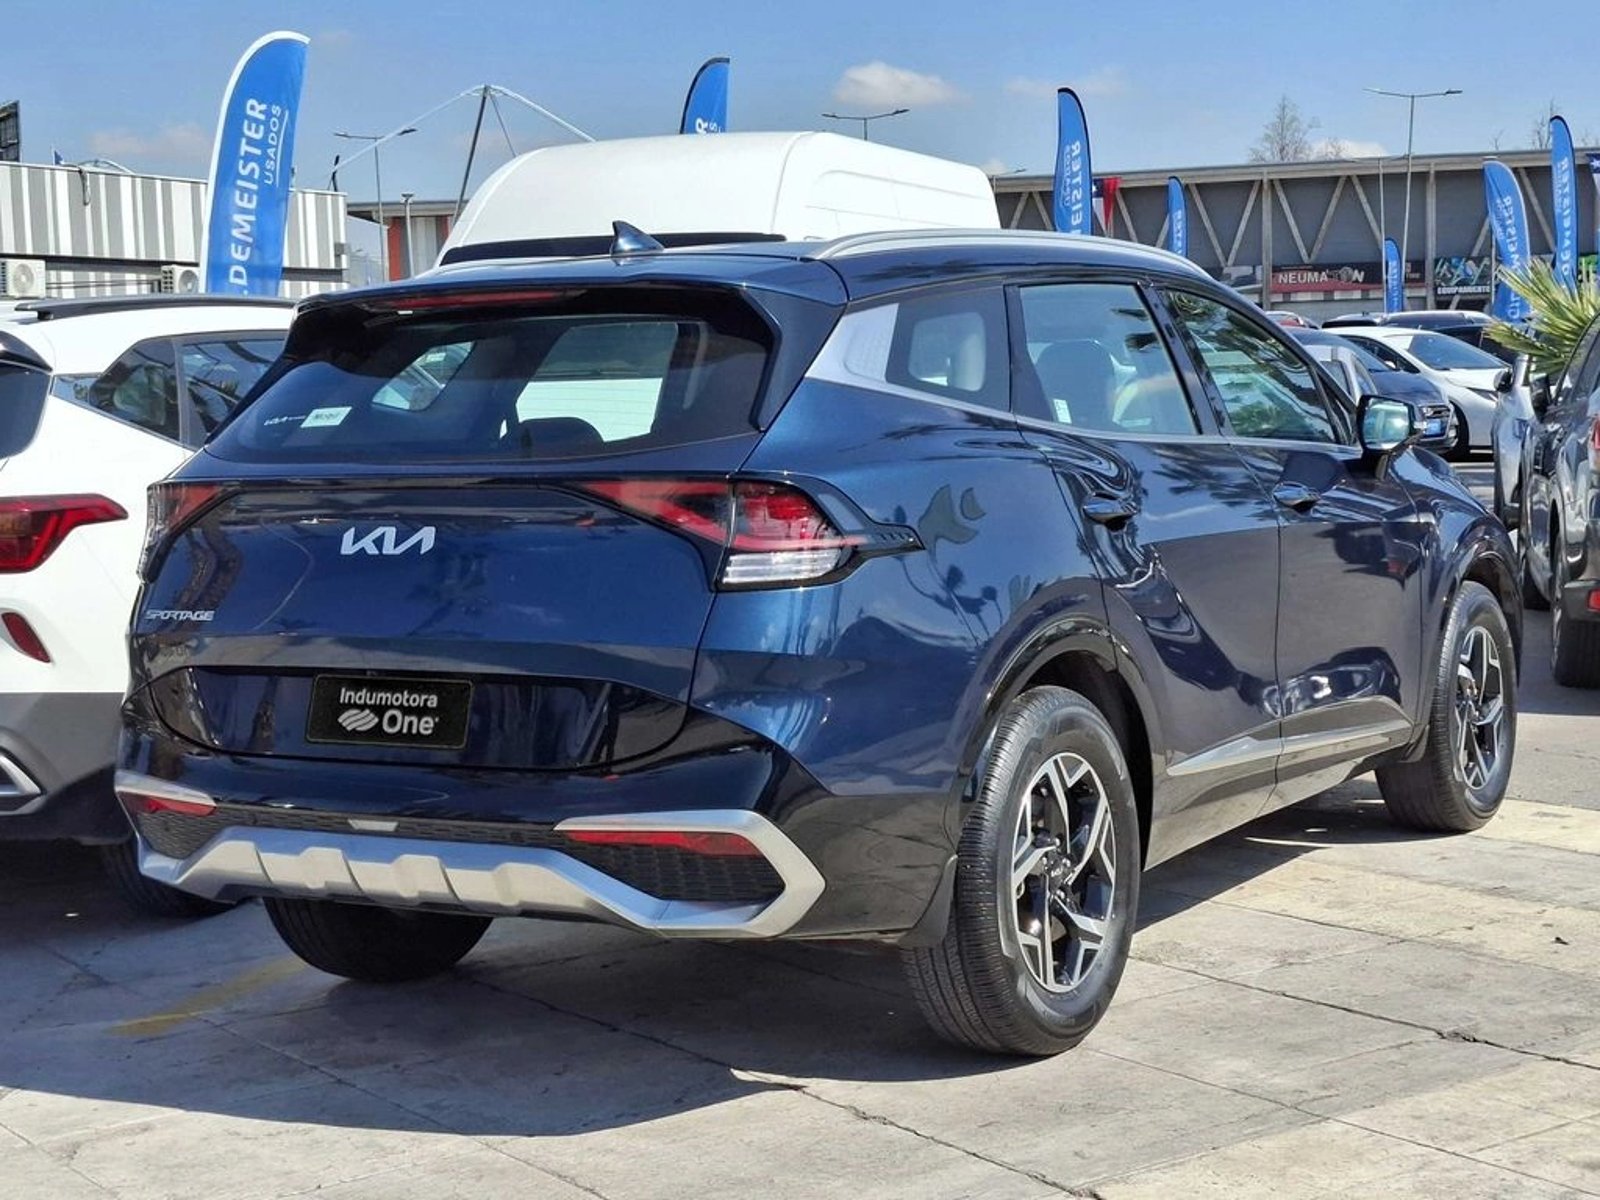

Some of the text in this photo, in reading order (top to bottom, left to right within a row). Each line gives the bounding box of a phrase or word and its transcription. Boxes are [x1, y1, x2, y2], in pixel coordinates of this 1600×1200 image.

[264, 104, 282, 185] USADOS
[229, 98, 267, 296] DEMEISTER
[340, 526, 437, 555] KIA
[145, 609, 215, 621] SPORTAGE
[339, 687, 438, 708] Indumotora
[382, 708, 436, 735] One
